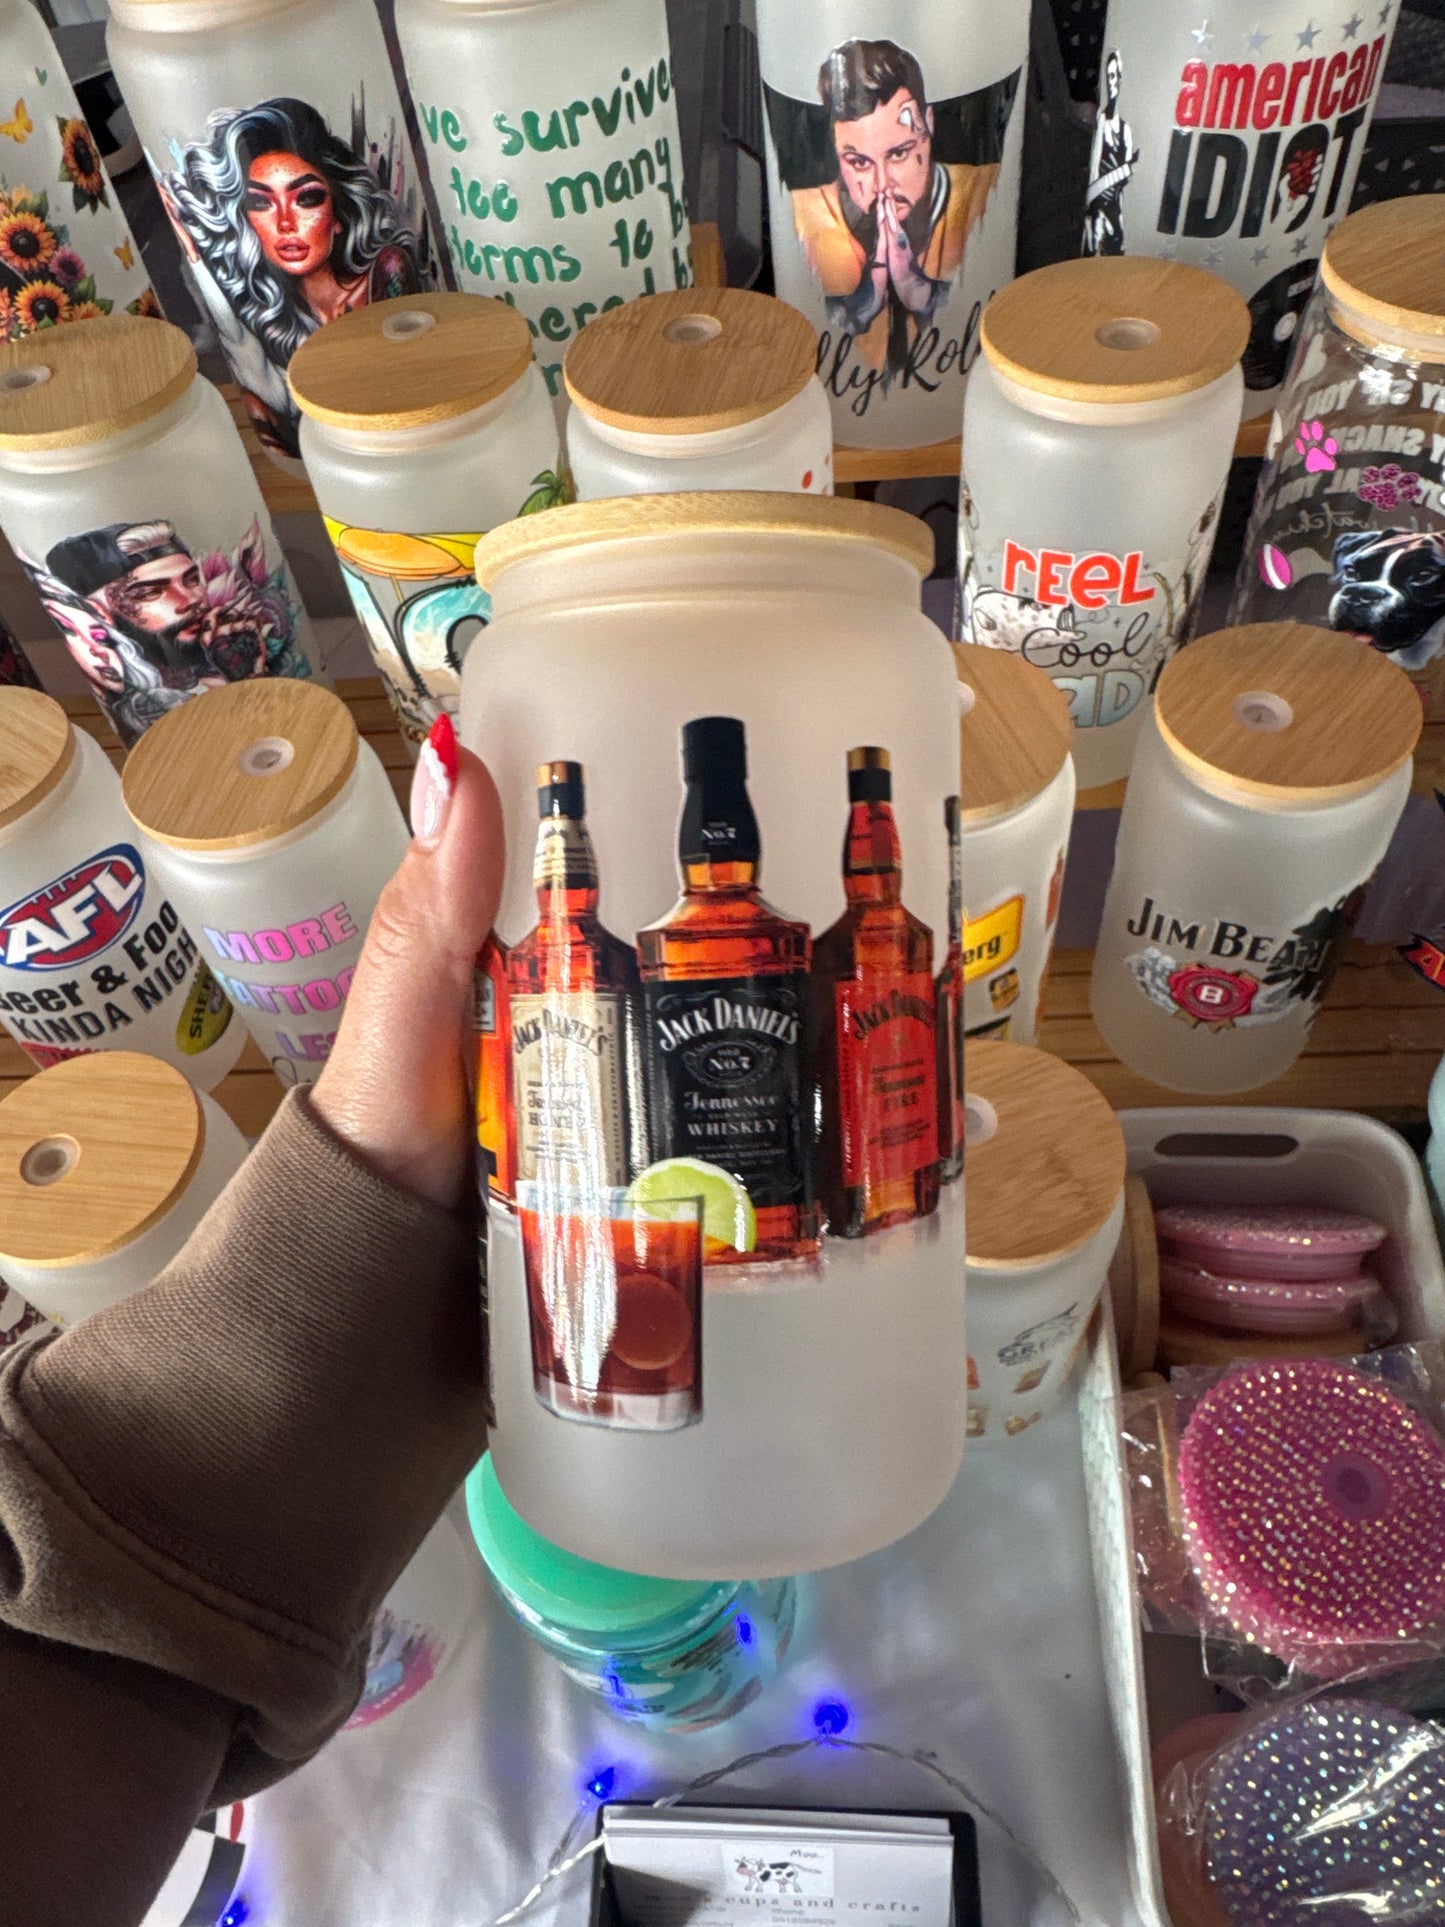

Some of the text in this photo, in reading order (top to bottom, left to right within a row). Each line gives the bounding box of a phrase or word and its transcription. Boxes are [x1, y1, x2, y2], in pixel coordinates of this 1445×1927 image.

[493, 57, 673, 156] survive
[1175, 33, 1387, 130] american
[546, 136, 675, 219] many
[1157, 102, 1370, 239] IDIOT
[451, 224, 582, 284] torms
[609, 218, 654, 268] to
[815, 290, 996, 417] lly Rol
[1021, 611, 1151, 669] Cool
[3, 861, 144, 966] AFL
[203, 901, 359, 965] MORE
[1127, 897, 1201, 951] JIM
[963, 935, 1002, 966] erg
[0, 979, 84, 1015] eer
[90, 964, 129, 994] &
[9, 926, 199, 1044] KINDA NIGH
[656, 997, 802, 1052] JACK DANIEL'S
[686, 1118, 778, 1137] WHISKEY
[792, 1899, 834, 1909] and
